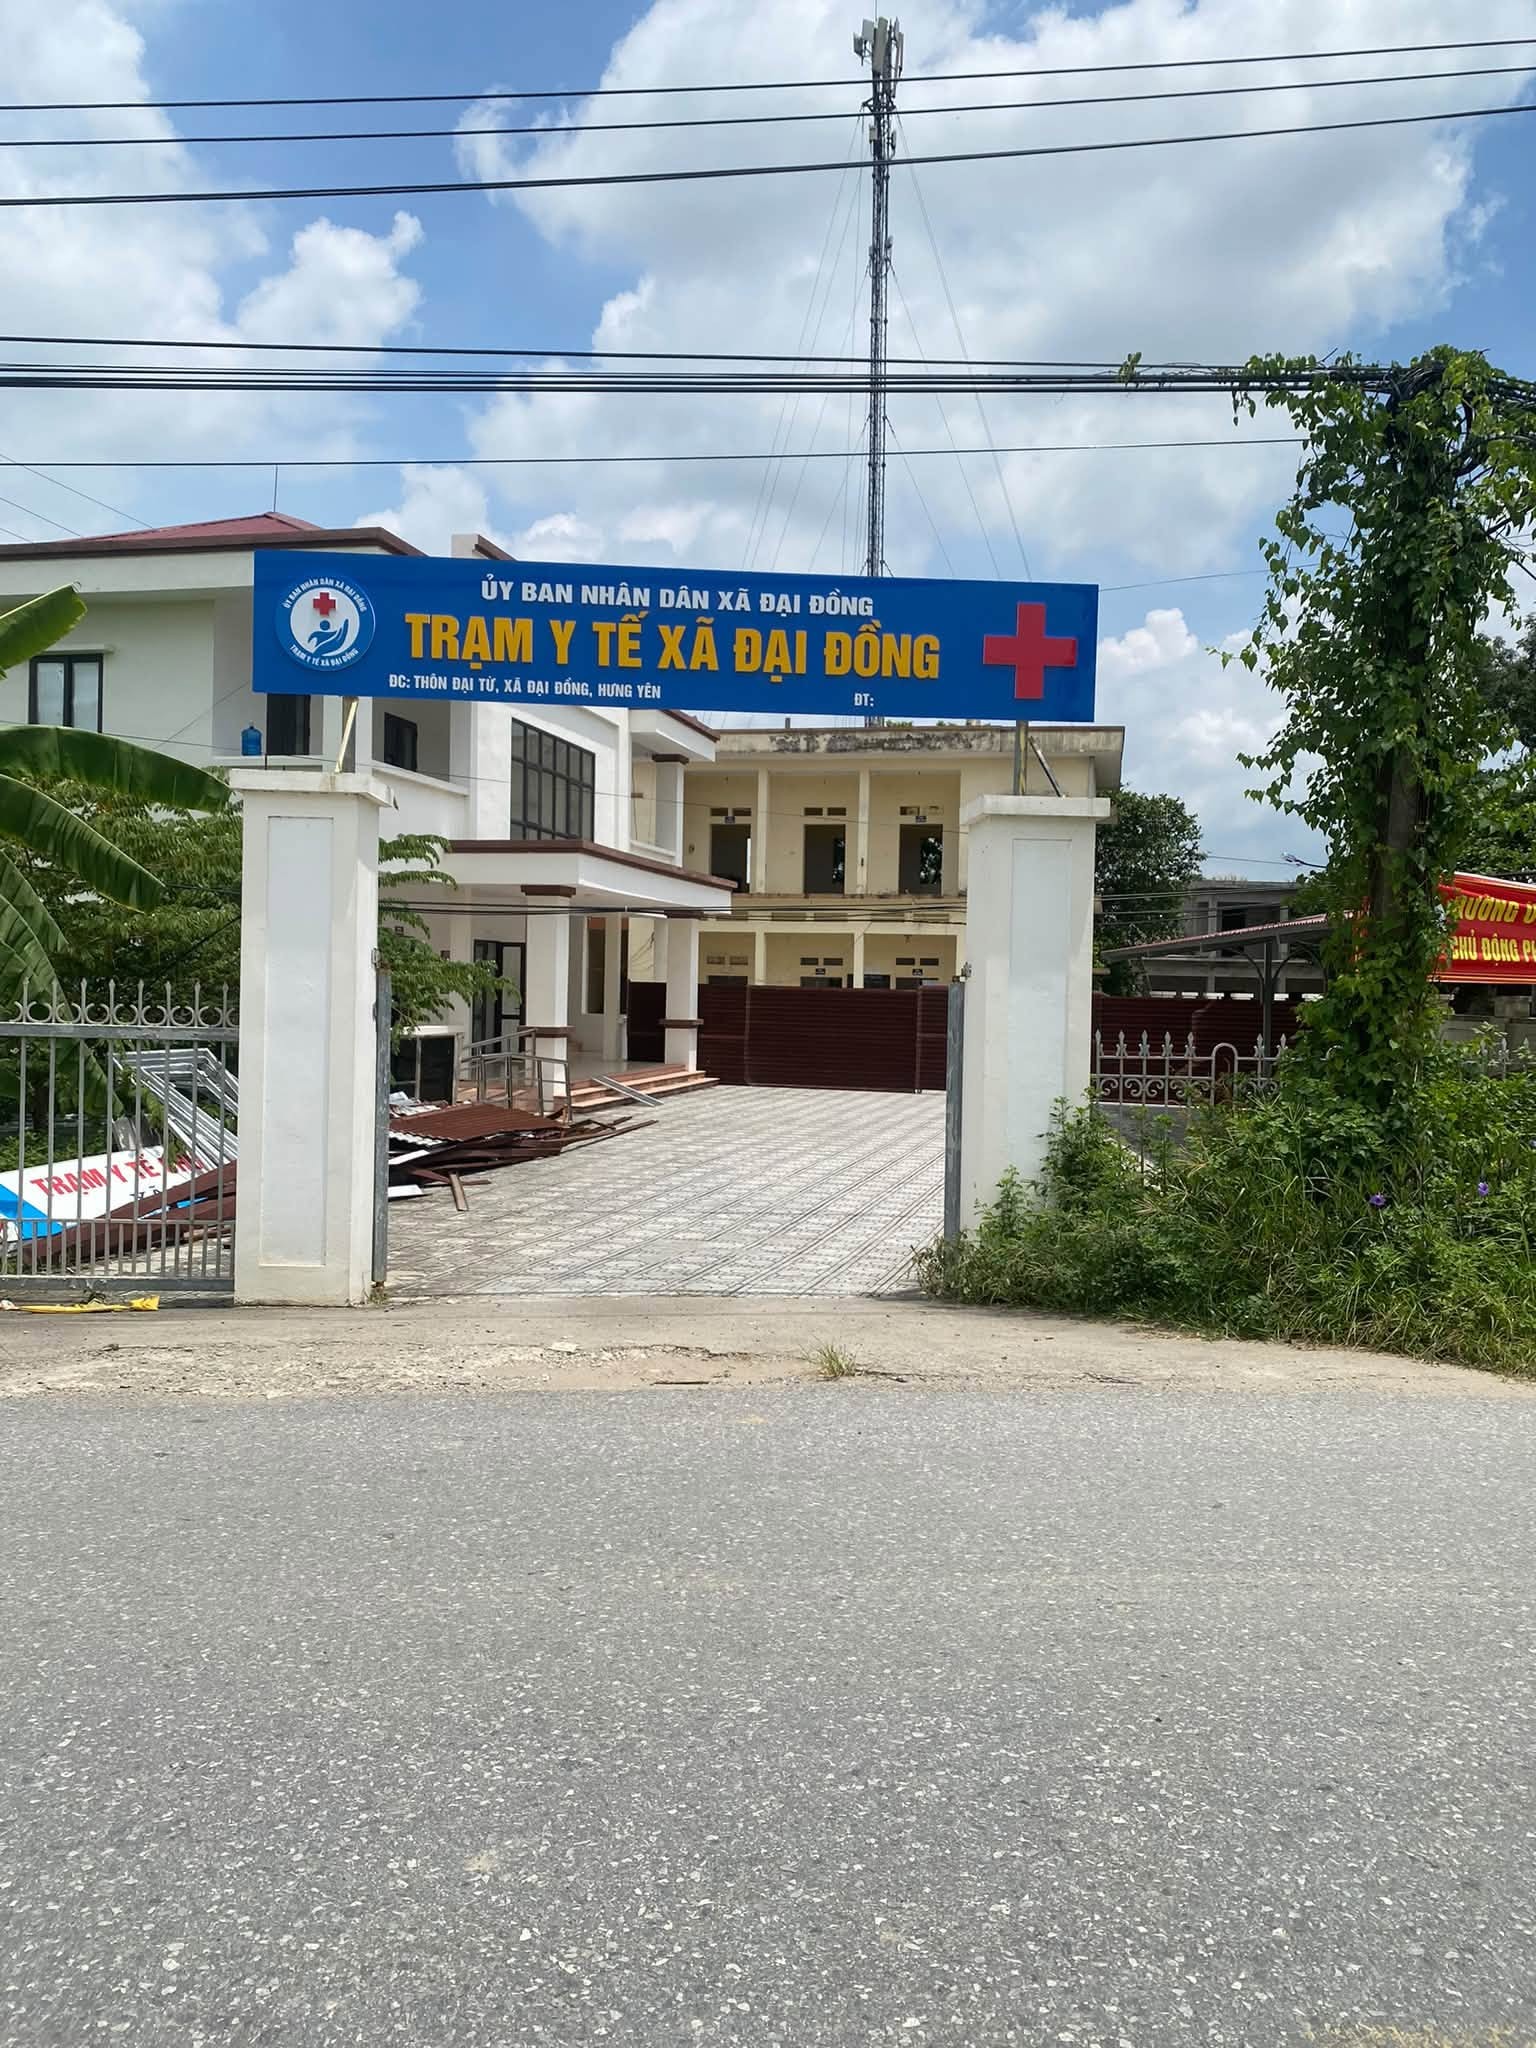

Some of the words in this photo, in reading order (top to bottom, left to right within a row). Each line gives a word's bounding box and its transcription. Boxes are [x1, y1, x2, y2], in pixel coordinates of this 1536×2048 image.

[481, 573, 514, 601] ỦY
[521, 582, 573, 604] BAN
[581, 582, 650, 607] NHÂN
[659, 585, 710, 610] DÂN
[717, 587, 751, 612] XÃ
[759, 592, 801, 617] ĐẠI
[808, 588, 874, 617] ĐỒNG
[405, 613, 534, 670] TRẠM
[549, 619, 577, 665] Y
[592, 611, 649, 668] TẾ
[657, 616, 720, 671] XÃ
[733, 627, 807, 683] ĐẠI
[824, 619, 941, 679] ĐỒNG
[389, 673, 411, 689] ĐC:
[413, 673, 448, 690] THÔN
[452, 677, 474, 694] ĐẠI
[504, 677, 522, 693] XÃ
[527, 680, 549, 696] ĐẠI
[554, 677, 593, 698] ĐỒNG,
[598, 683, 633, 698] HƯNG
[637, 682, 661, 699] YÊN
[854, 692, 874, 707] ĐT:
[1450, 929, 1478, 961] CHỦ
[1481, 933, 1521, 966] ĐỘNG
[30, 1168, 109, 1196] TRẠM
